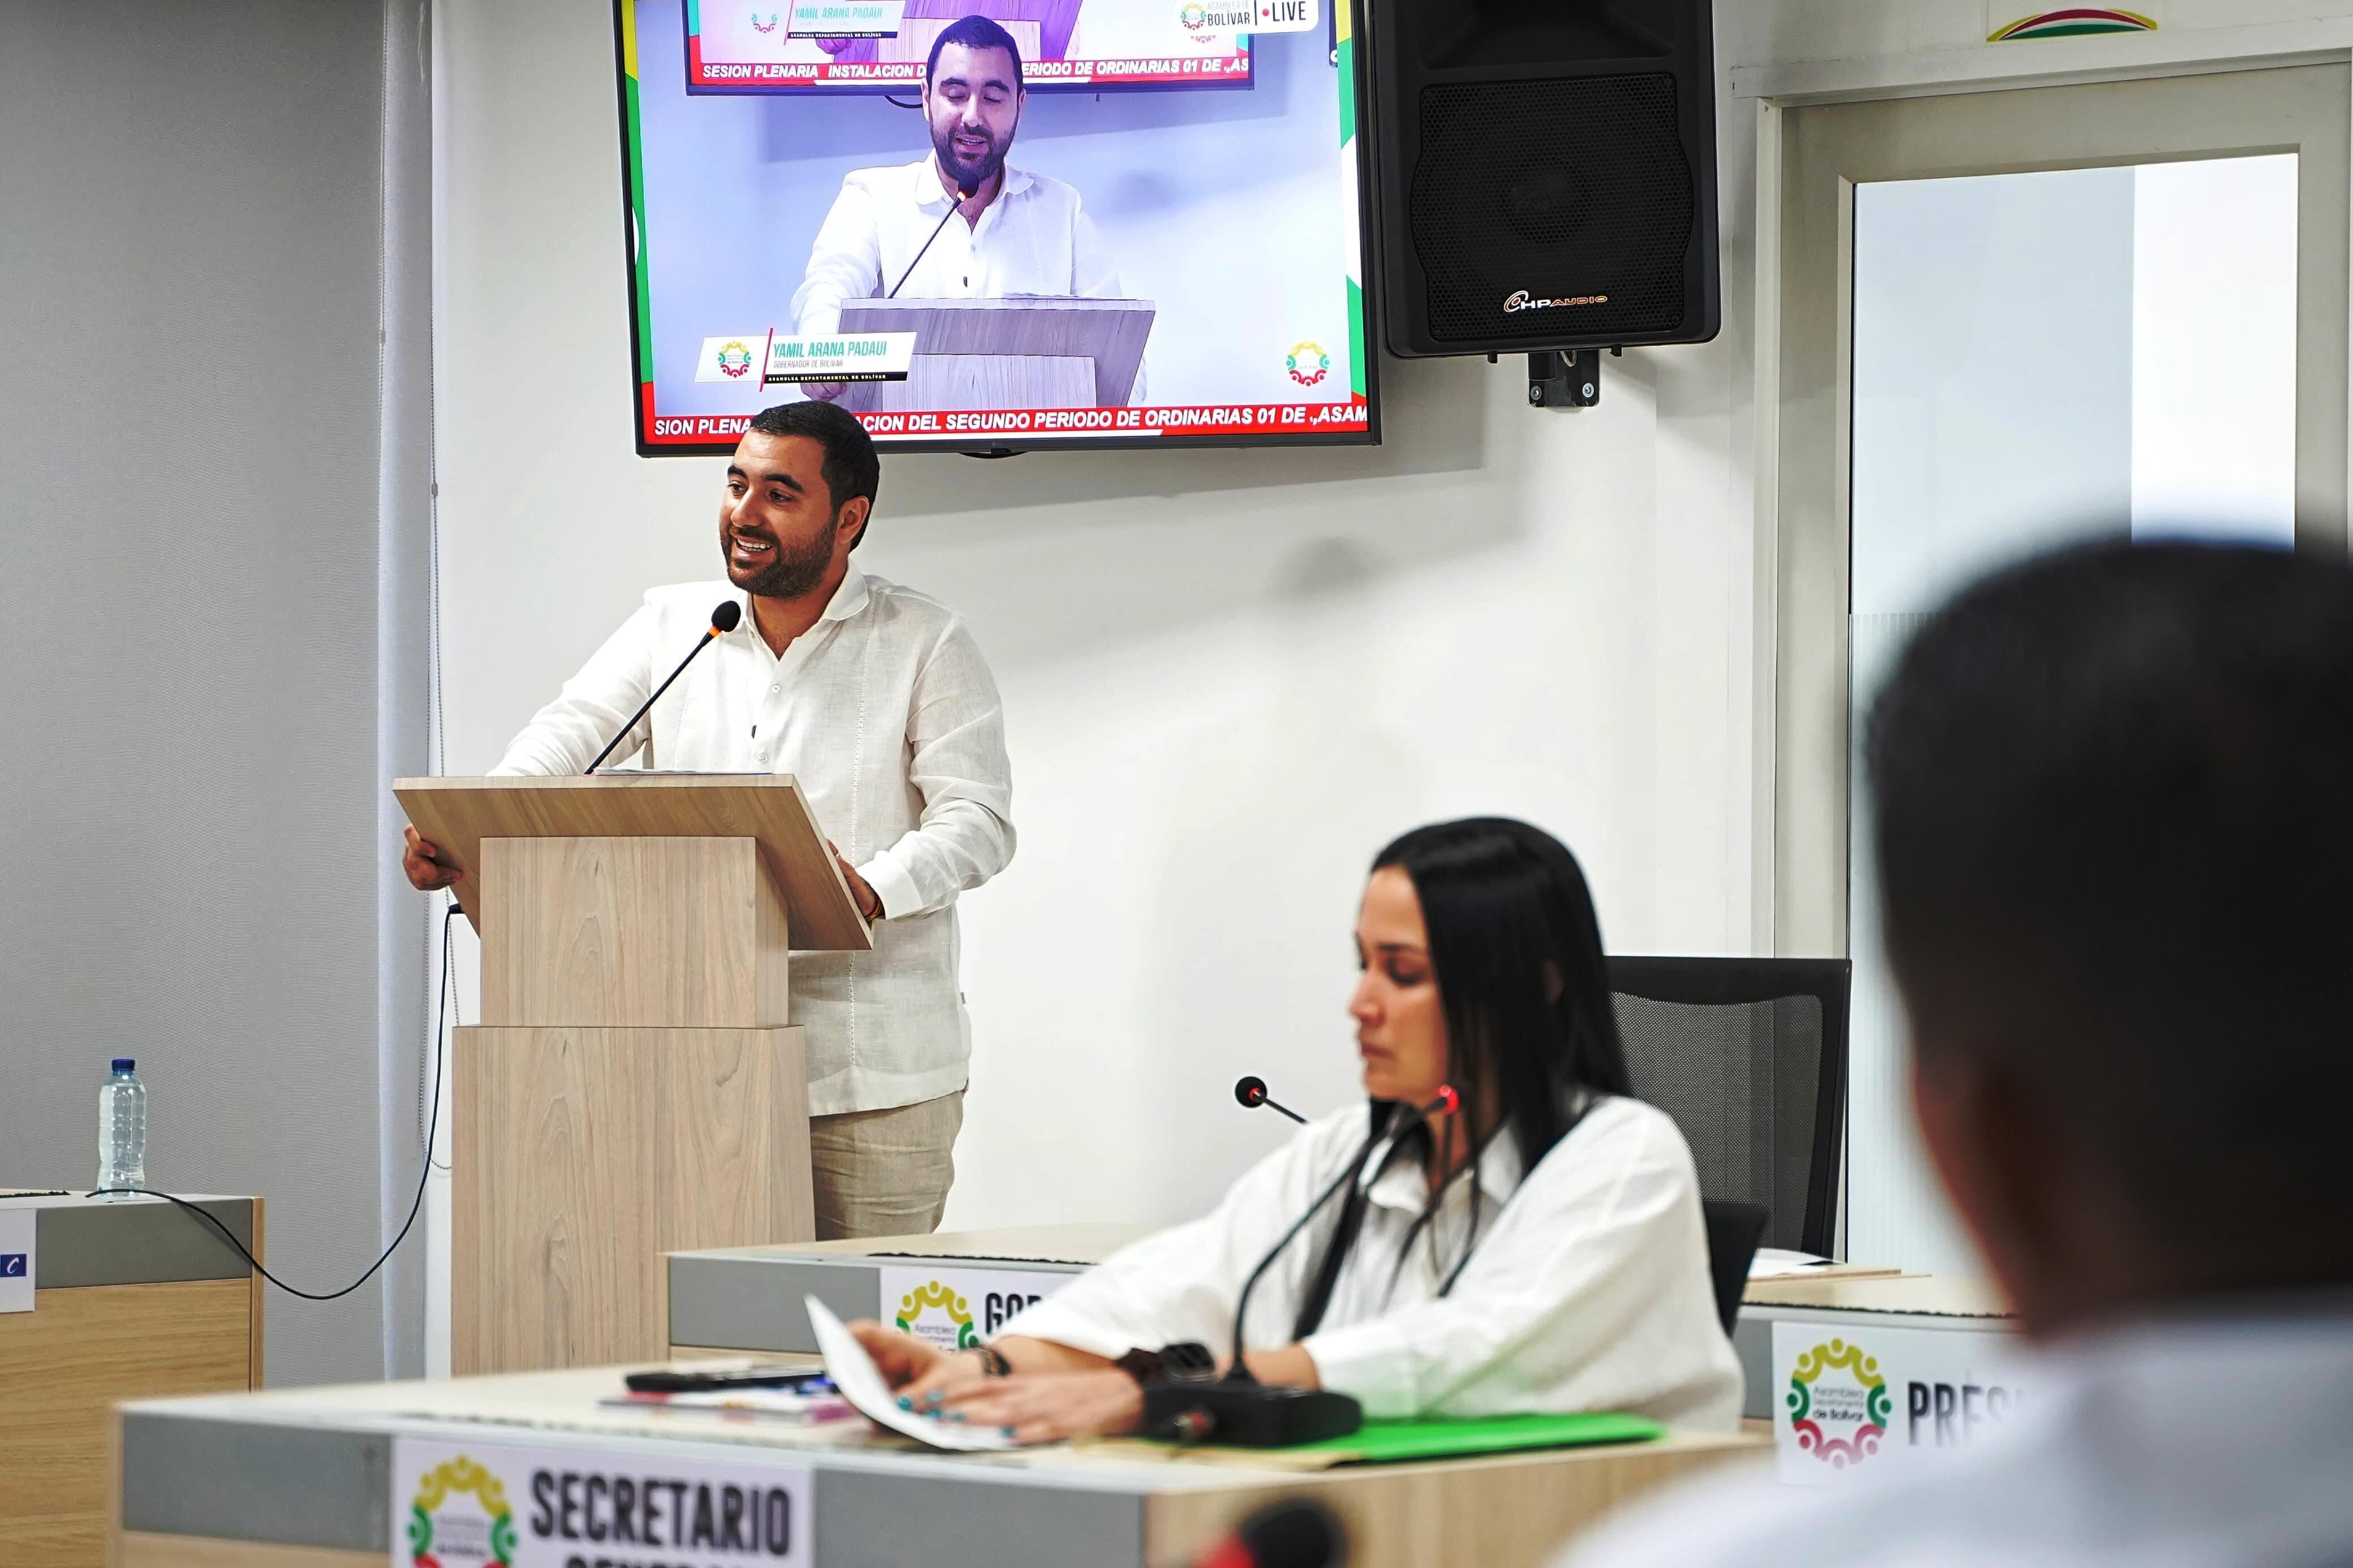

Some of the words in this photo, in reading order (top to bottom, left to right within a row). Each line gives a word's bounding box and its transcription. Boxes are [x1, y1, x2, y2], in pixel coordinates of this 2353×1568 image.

[795, 7, 819, 19] YAMIL
[821, 7, 849, 19] ARANA
[1208, 10, 1250, 26] BOLÍVAR
[1272, 1, 1306, 21] LIVE
[703, 65, 751, 78] SESION
[754, 64, 819, 78] PLENARIA
[828, 64, 915, 77] INSTALACION
[1022, 62, 1071, 76] ERIODO
[1075, 62, 1093, 75] DE
[1096, 59, 1180, 75] ORDINARIAS
[1183, 59, 1198, 74] 01
[1201, 58, 1222, 73] DE
[773, 342, 805, 358] YAMIL
[808, 341, 844, 357] ARANA
[847, 341, 887, 356] PADAUI
[773, 360, 809, 369] GOBERNADOR
[655, 419, 694, 435] SION
[698, 418, 751, 434] PLENA
[908, 414, 942, 430] DEL
[946, 412, 1031, 430] SEGUNDO
[1034, 411, 1112, 428] PERIODO
[1116, 410, 1141, 427] DE
[1144, 407, 1253, 426] ORDINARIAS
[1257, 407, 1277, 424] 01
[1281, 407, 1307, 423] DE
[531, 1469, 791, 1557] SECRETARIO
